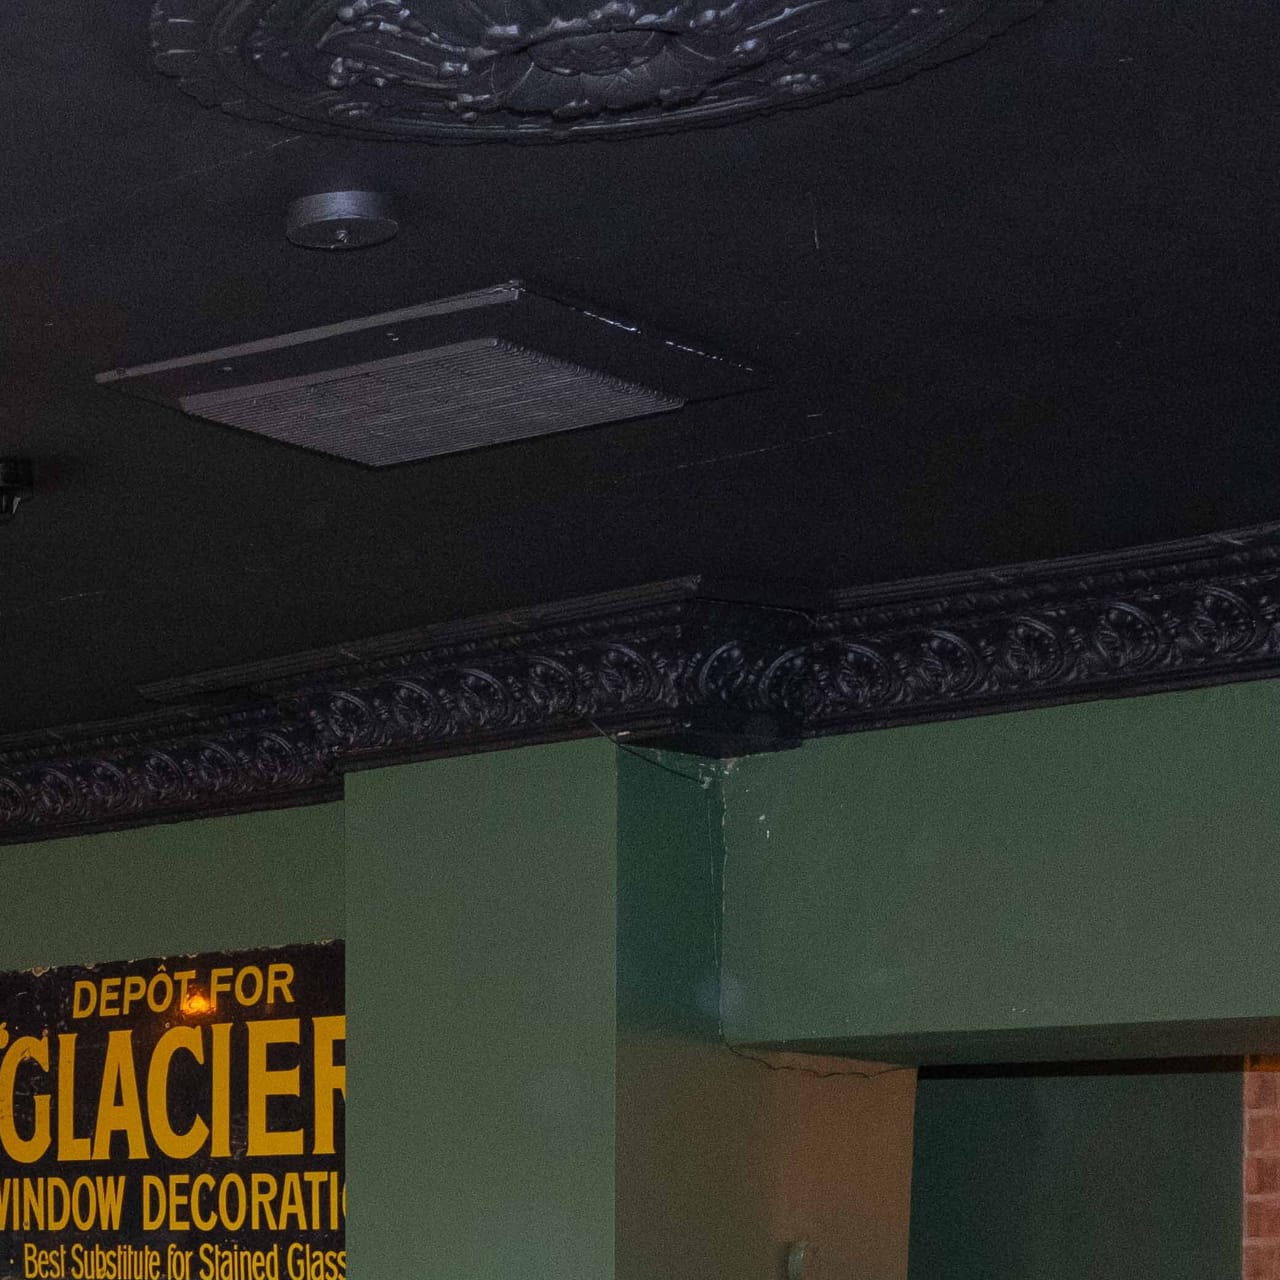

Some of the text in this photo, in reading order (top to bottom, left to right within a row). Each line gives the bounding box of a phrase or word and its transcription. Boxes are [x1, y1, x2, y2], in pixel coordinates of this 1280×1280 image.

[210, 962, 296, 1012] FOR
[142, 1171, 346, 1232] DECORATI
[23, 1242, 66, 1279] Best
[71, 1242, 161, 1280] Substitute
[166, 1242, 194, 1280] for
